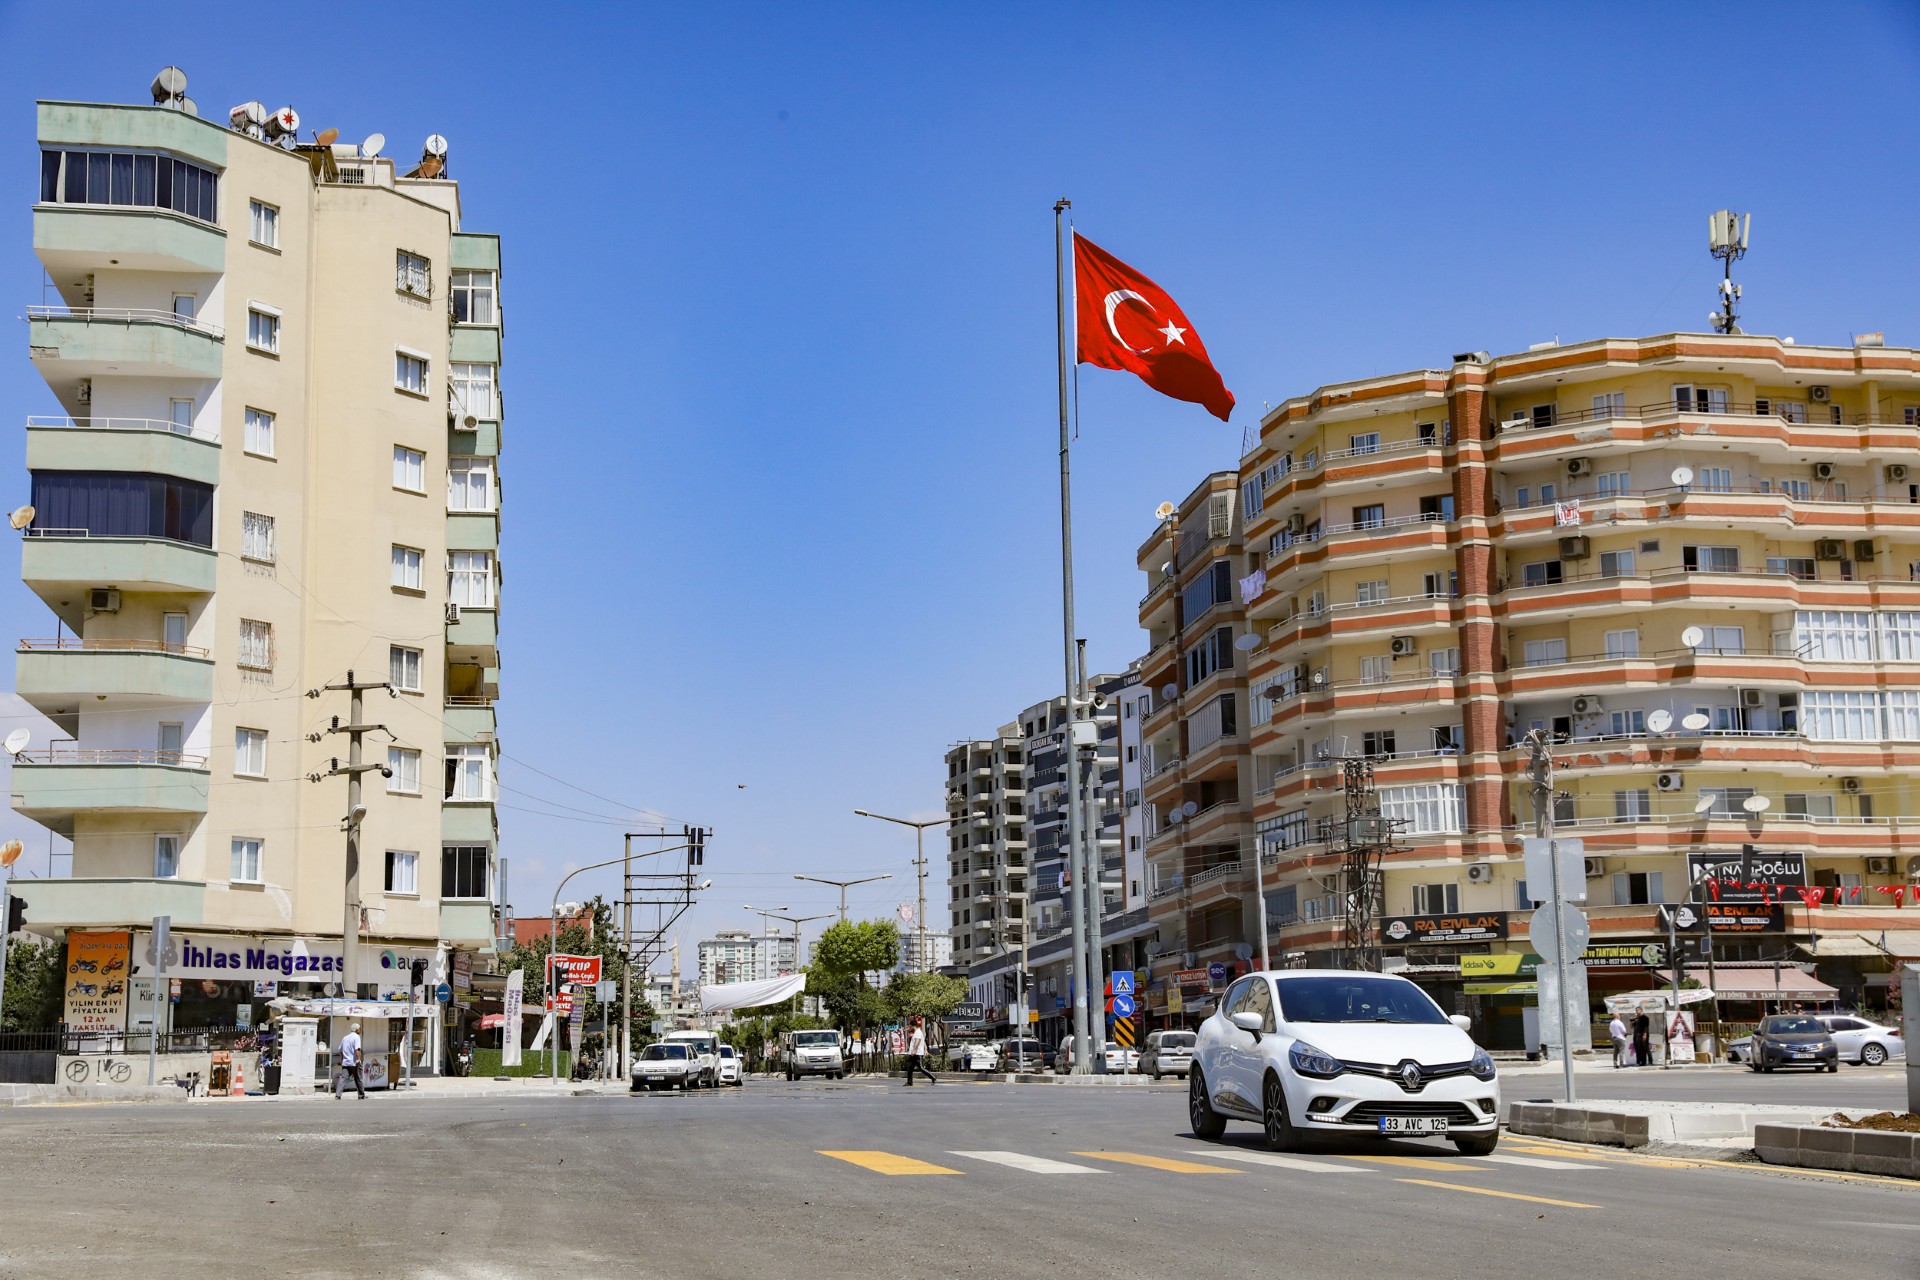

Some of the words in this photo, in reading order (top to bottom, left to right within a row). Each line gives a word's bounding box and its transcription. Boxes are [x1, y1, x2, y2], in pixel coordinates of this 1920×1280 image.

[1724, 906, 1774, 916] EMLAK
[1414, 920, 1437, 930] RA
[1440, 916, 1500, 929] EMLAK
[183, 939, 241, 968] İhlas
[246, 949, 343, 976] Mağazas
[1386, 1118, 1398, 1130] 33
[1405, 1118, 1422, 1130] AVC
[1430, 1118, 1446, 1130] 125
